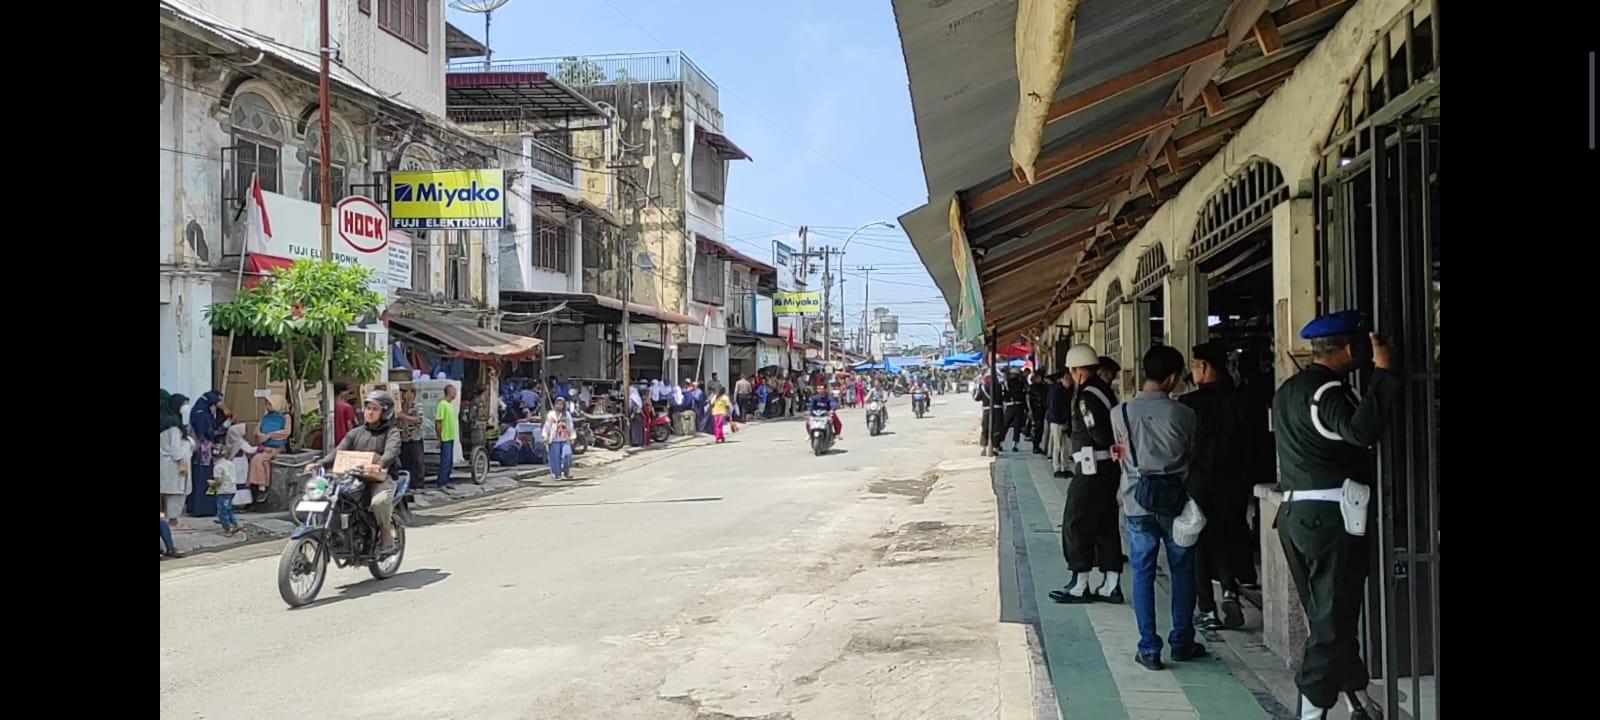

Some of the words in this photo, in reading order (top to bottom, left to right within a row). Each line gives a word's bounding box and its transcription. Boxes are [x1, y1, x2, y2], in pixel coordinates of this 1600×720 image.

[416, 181, 500, 208] Miyako
[344, 209, 383, 240] HOCK
[394, 218, 419, 228] FUJI
[426, 218, 499, 228] ELEKTRONIK
[288, 244, 308, 257] FUJI
[310, 247, 359, 264] ELTRONIK
[784, 297, 819, 307] Miyako
